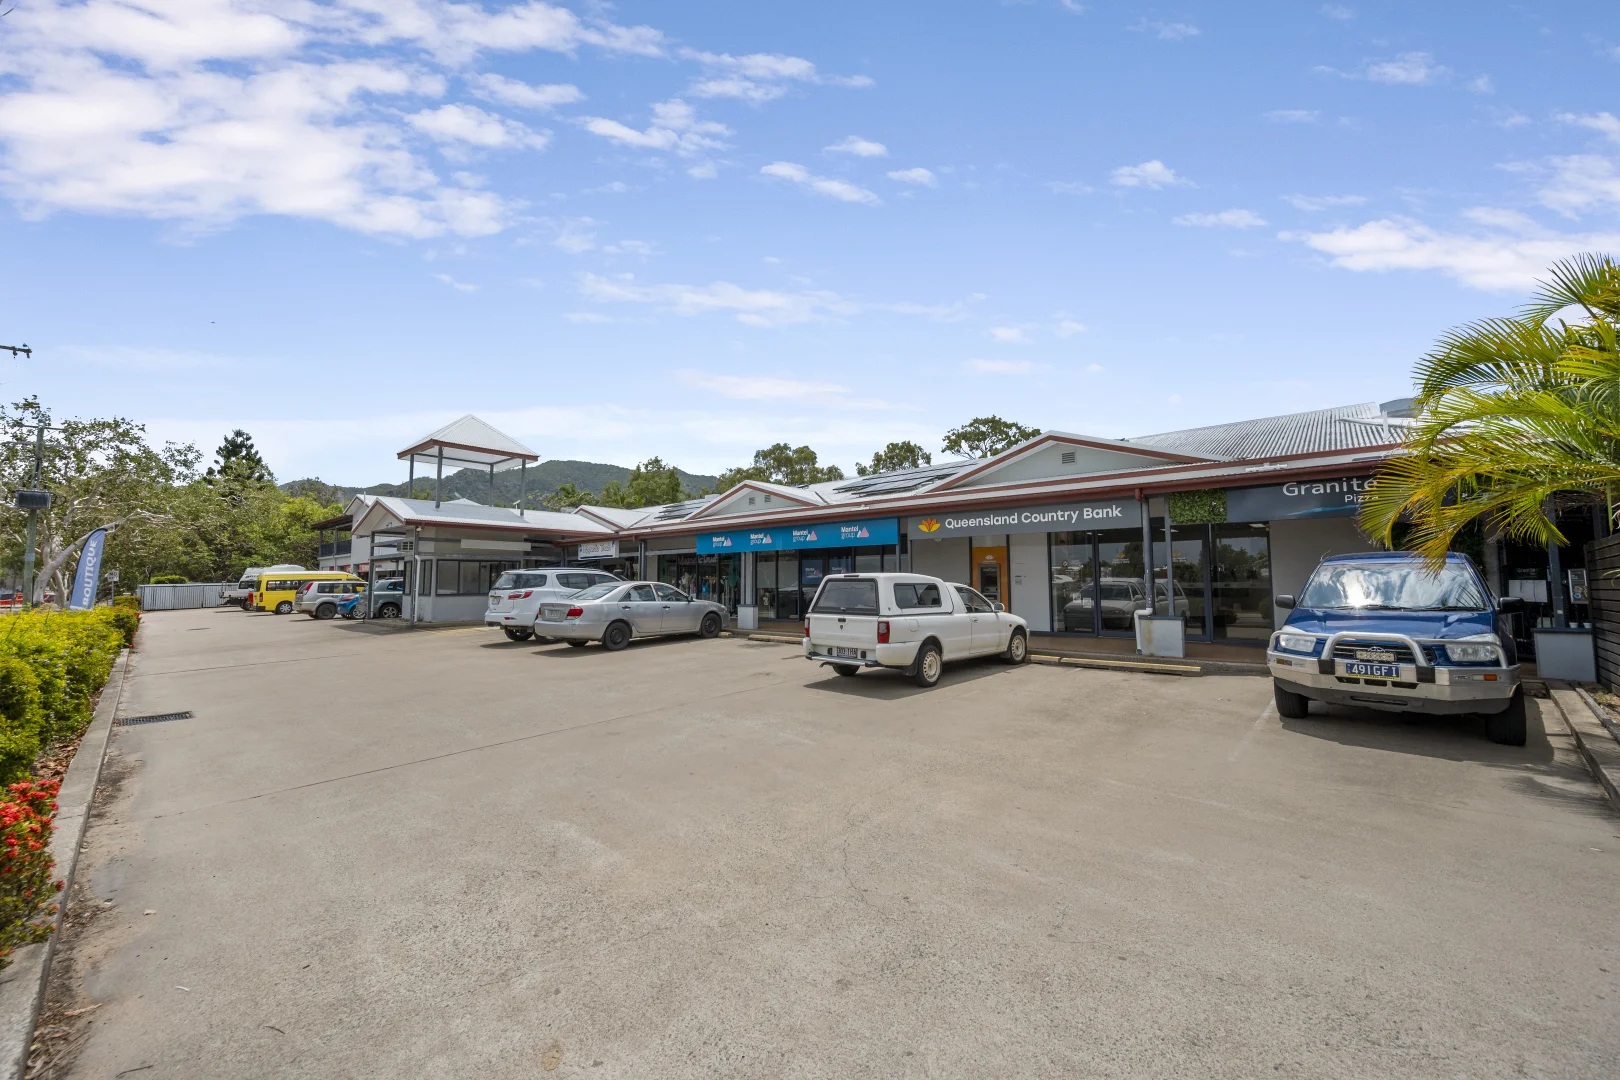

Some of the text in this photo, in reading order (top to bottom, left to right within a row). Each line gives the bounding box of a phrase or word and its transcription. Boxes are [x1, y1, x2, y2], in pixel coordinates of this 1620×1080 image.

[841, 525, 859, 533] Mantel
[945, 505, 1122, 529] Queensland Country Bank
[83, 540, 97, 605] BOUTIQUE
